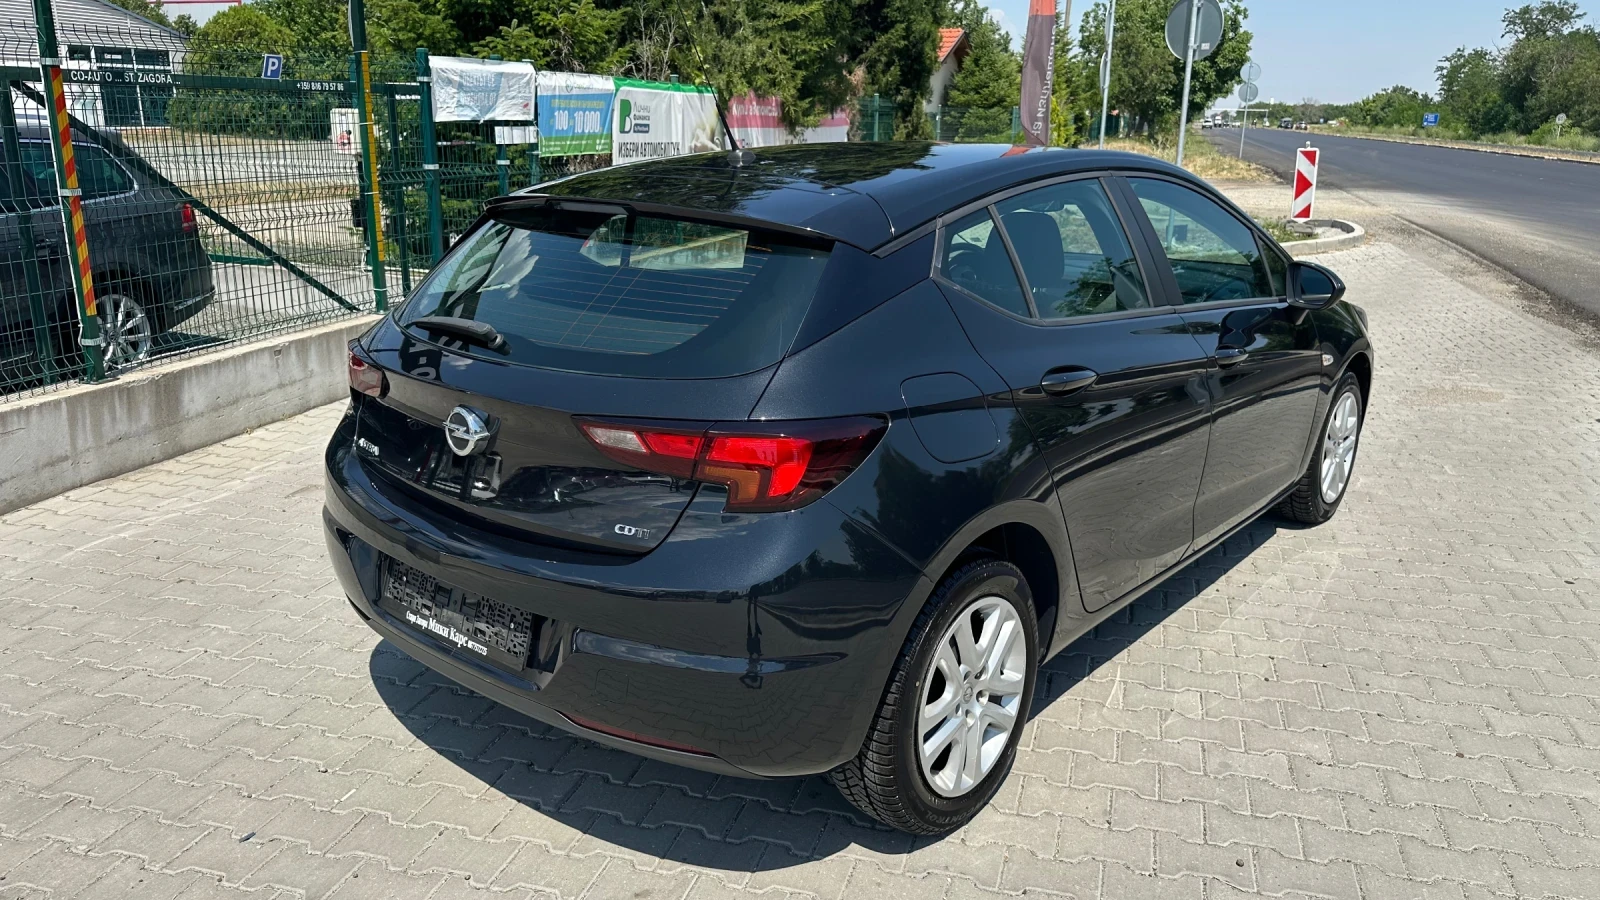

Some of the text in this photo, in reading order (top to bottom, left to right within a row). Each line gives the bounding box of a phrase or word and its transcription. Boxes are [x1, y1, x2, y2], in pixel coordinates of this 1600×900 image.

[267, 58, 279, 77] P
[137, 72, 172, 84] ZAGORA
[554, 110, 569, 131] 100
[618, 141, 639, 158] ИЗБЕРИ
[614, 523, 650, 540] CDTI
[428, 617, 450, 638] Мики
[449, 627, 468, 648] Карс
